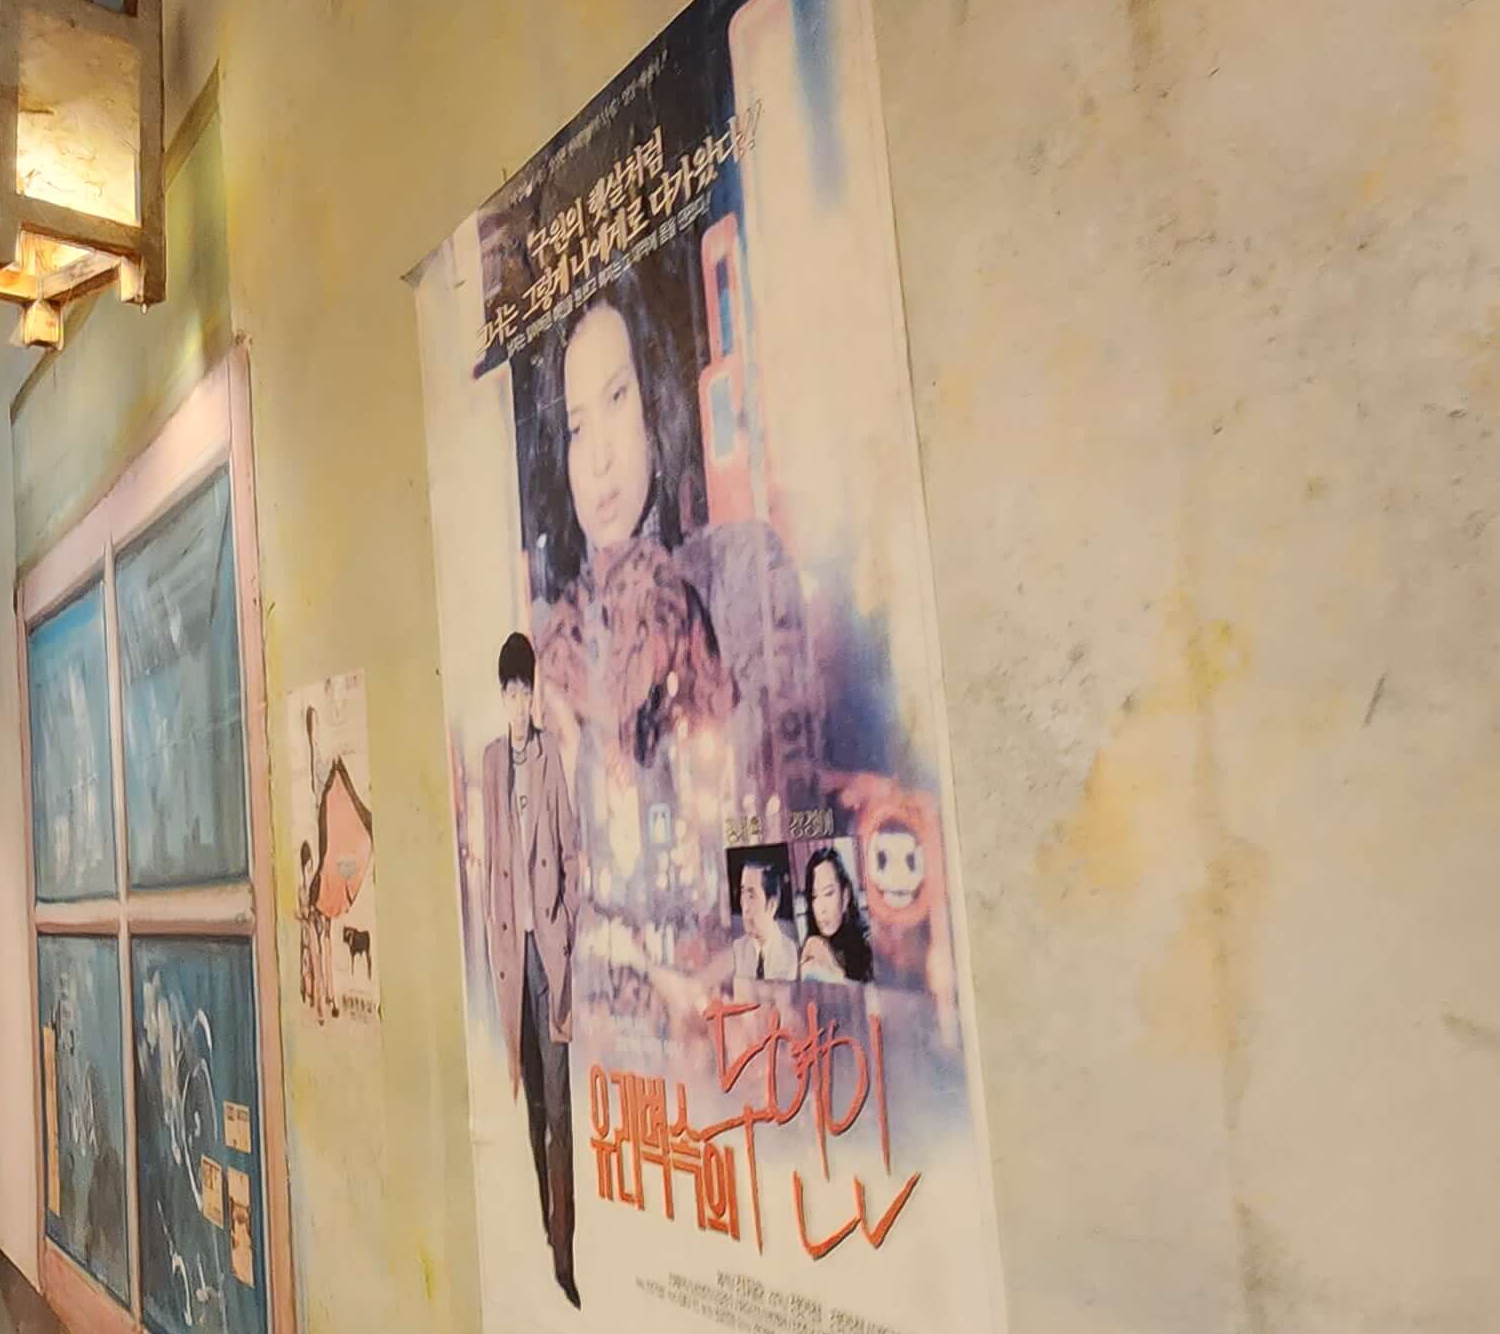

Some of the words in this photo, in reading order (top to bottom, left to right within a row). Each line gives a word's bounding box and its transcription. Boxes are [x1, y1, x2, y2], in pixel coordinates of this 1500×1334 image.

[588, 125, 666, 227] 햇살처럼
[522, 253, 571, 321] 그렇게
[571, 196, 649, 279] 나에게로
